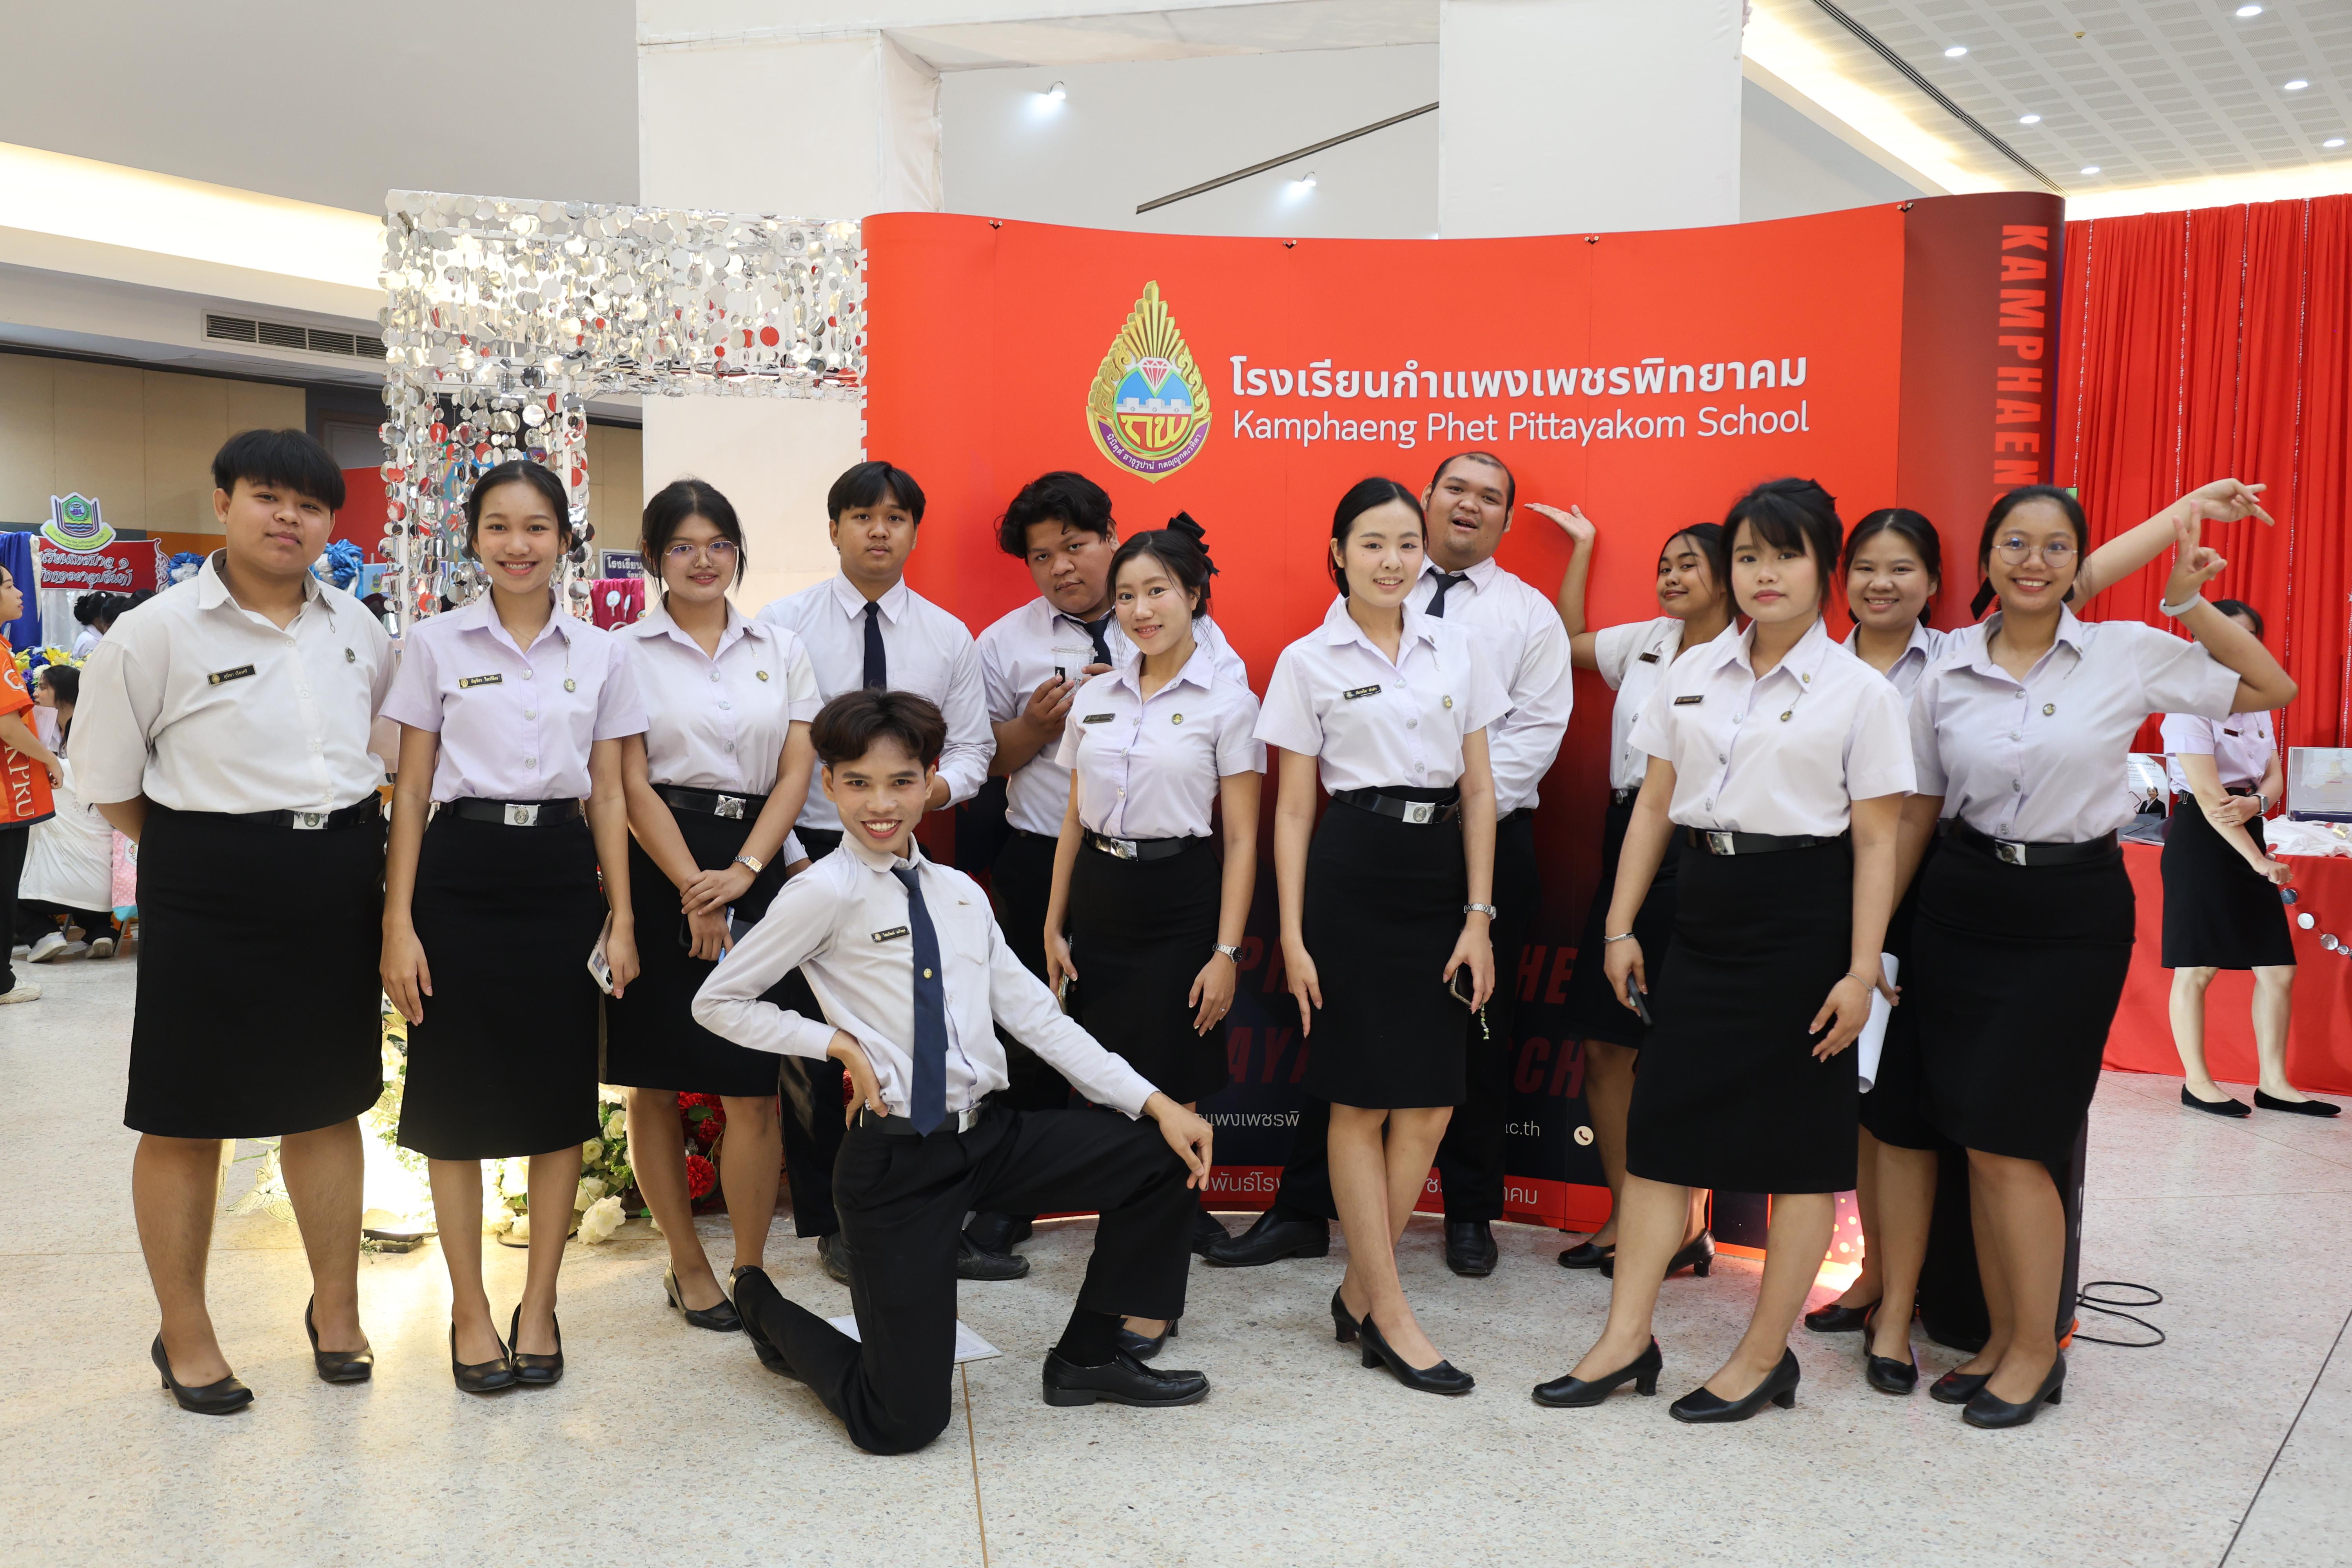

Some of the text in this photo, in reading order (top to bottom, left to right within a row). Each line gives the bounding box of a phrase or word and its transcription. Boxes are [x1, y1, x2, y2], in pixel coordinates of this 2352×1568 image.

[1230, 356, 1807, 399] โรงเรียนกำแพงเพชรพิทยาคม
[1993, 225, 2047, 505] KAMPHAEN
[1234, 400, 1809, 449] Kamphaeng Phet Pittayakom School
[606, 556, 643, 569] โรงเรียน
[1201, 1111, 1300, 1127] แพงเพชรพิ
[1203, 1171, 1280, 1192] พันธ์โร
[1504, 1186, 1537, 1205] าคม
